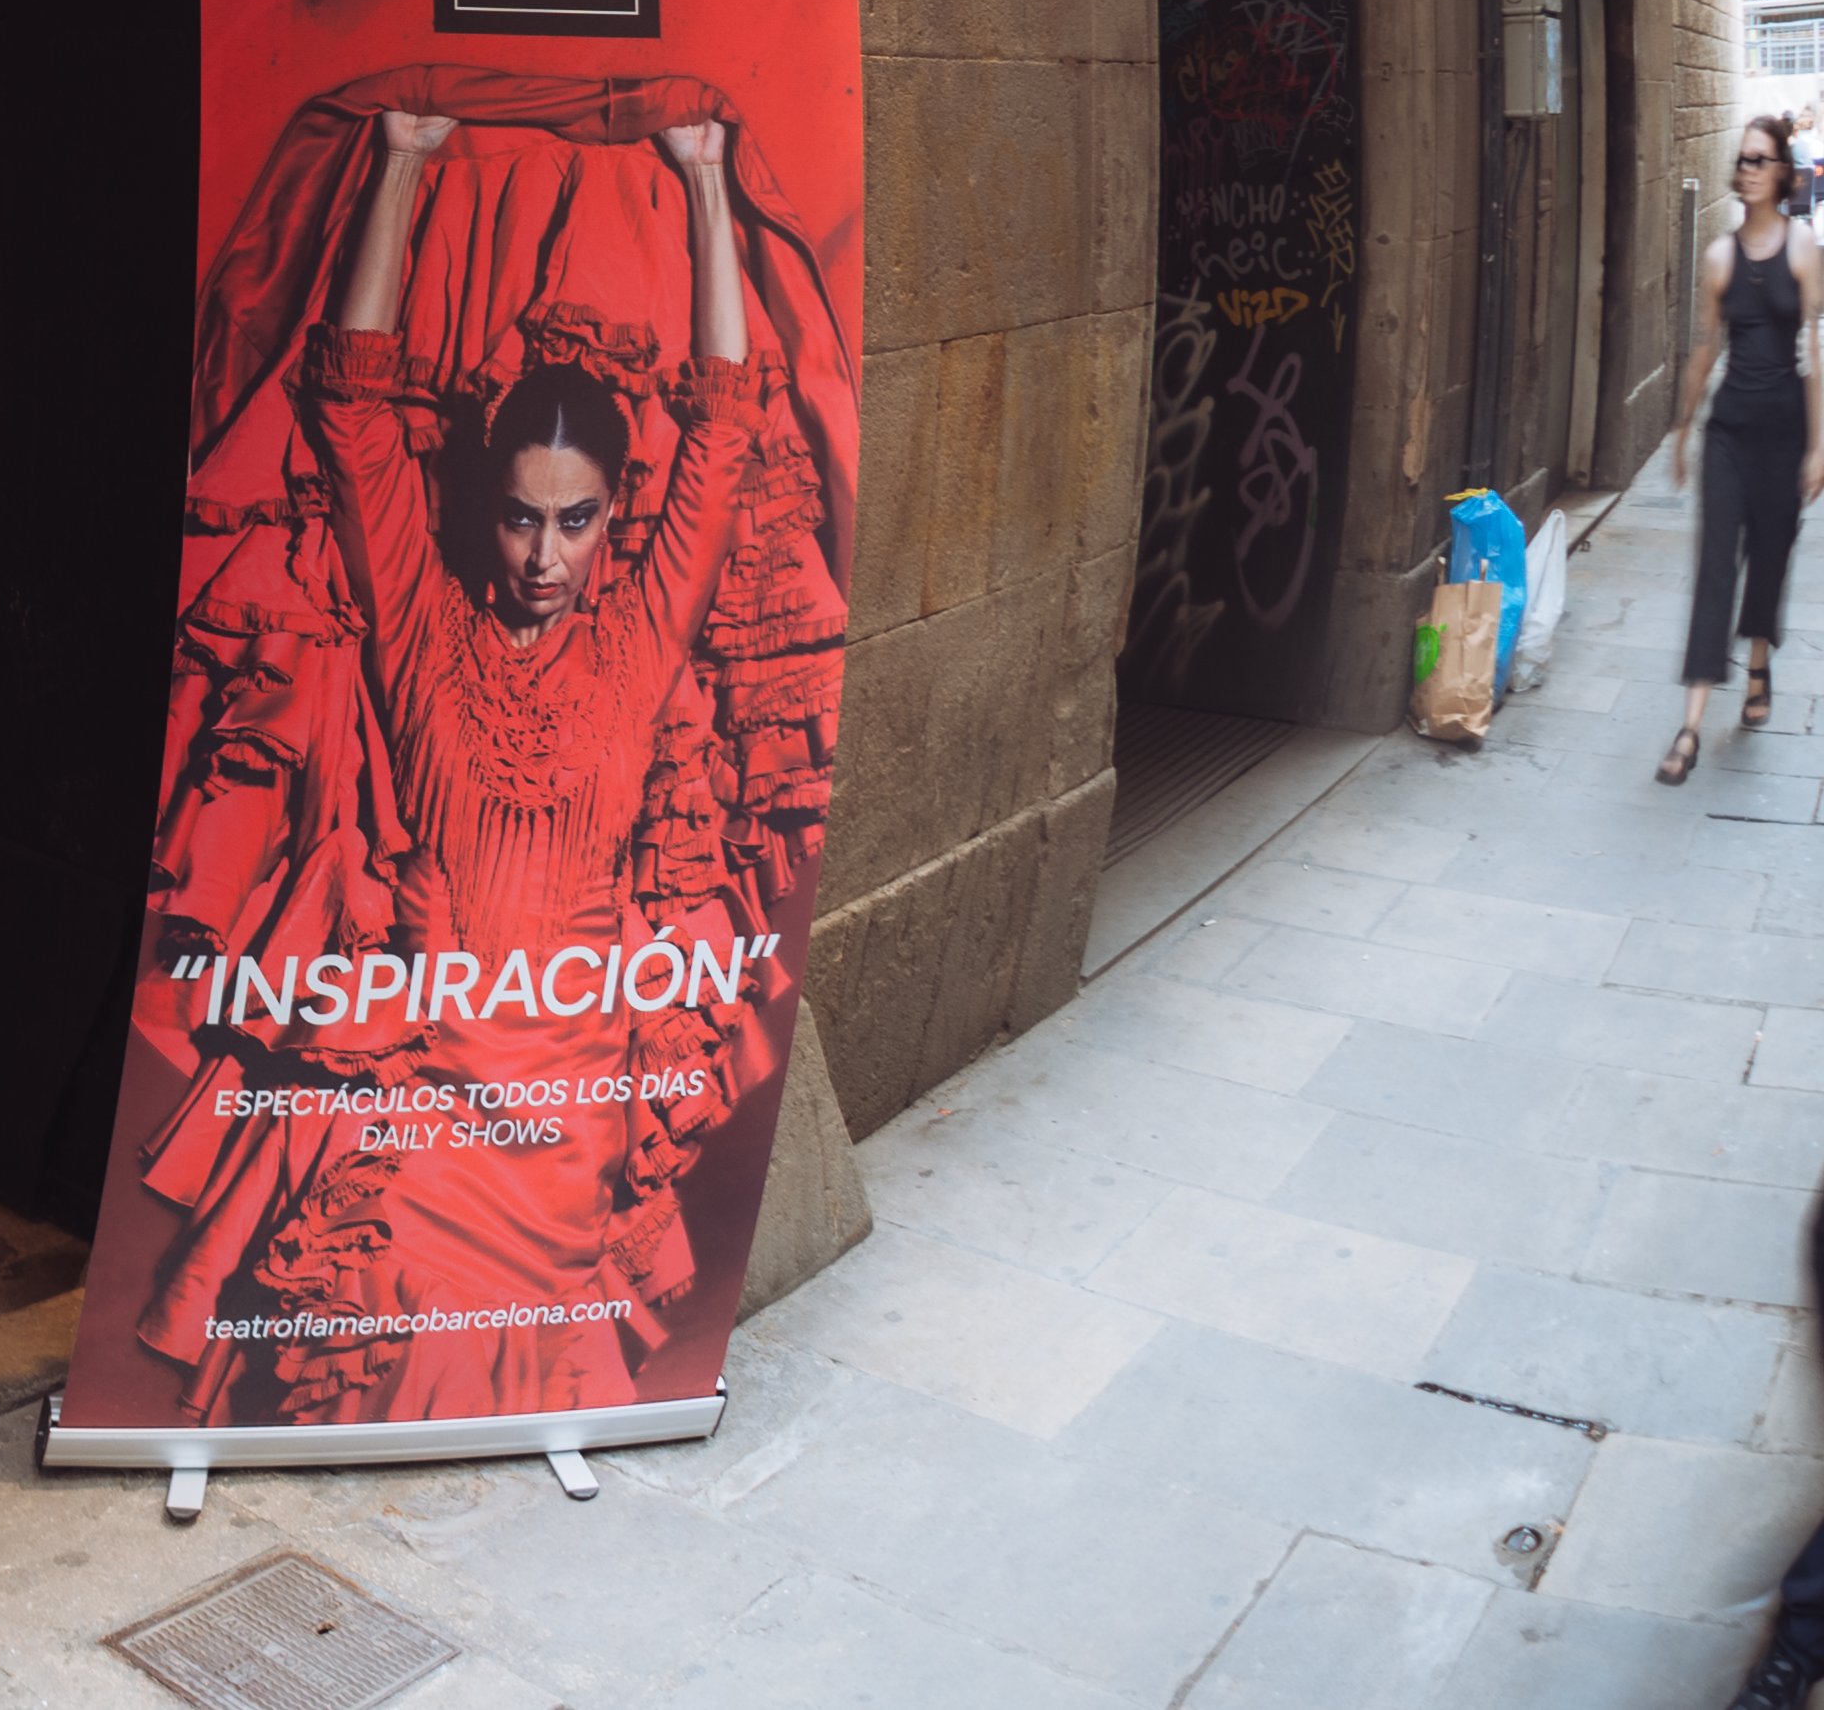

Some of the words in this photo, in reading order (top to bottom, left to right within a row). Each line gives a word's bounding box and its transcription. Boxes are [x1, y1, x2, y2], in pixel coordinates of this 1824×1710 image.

[214, 1081, 456, 1117] ESPECTÁCULOS
[465, 1076, 570, 1111] TODOS
[575, 1074, 633, 1105] LOS
[639, 1067, 706, 1101] DÍAS
[359, 1121, 440, 1152] DAILY
[449, 1117, 563, 1149] SHOWS
[204, 1298, 632, 1341] teatroflamencobarcelona.com
